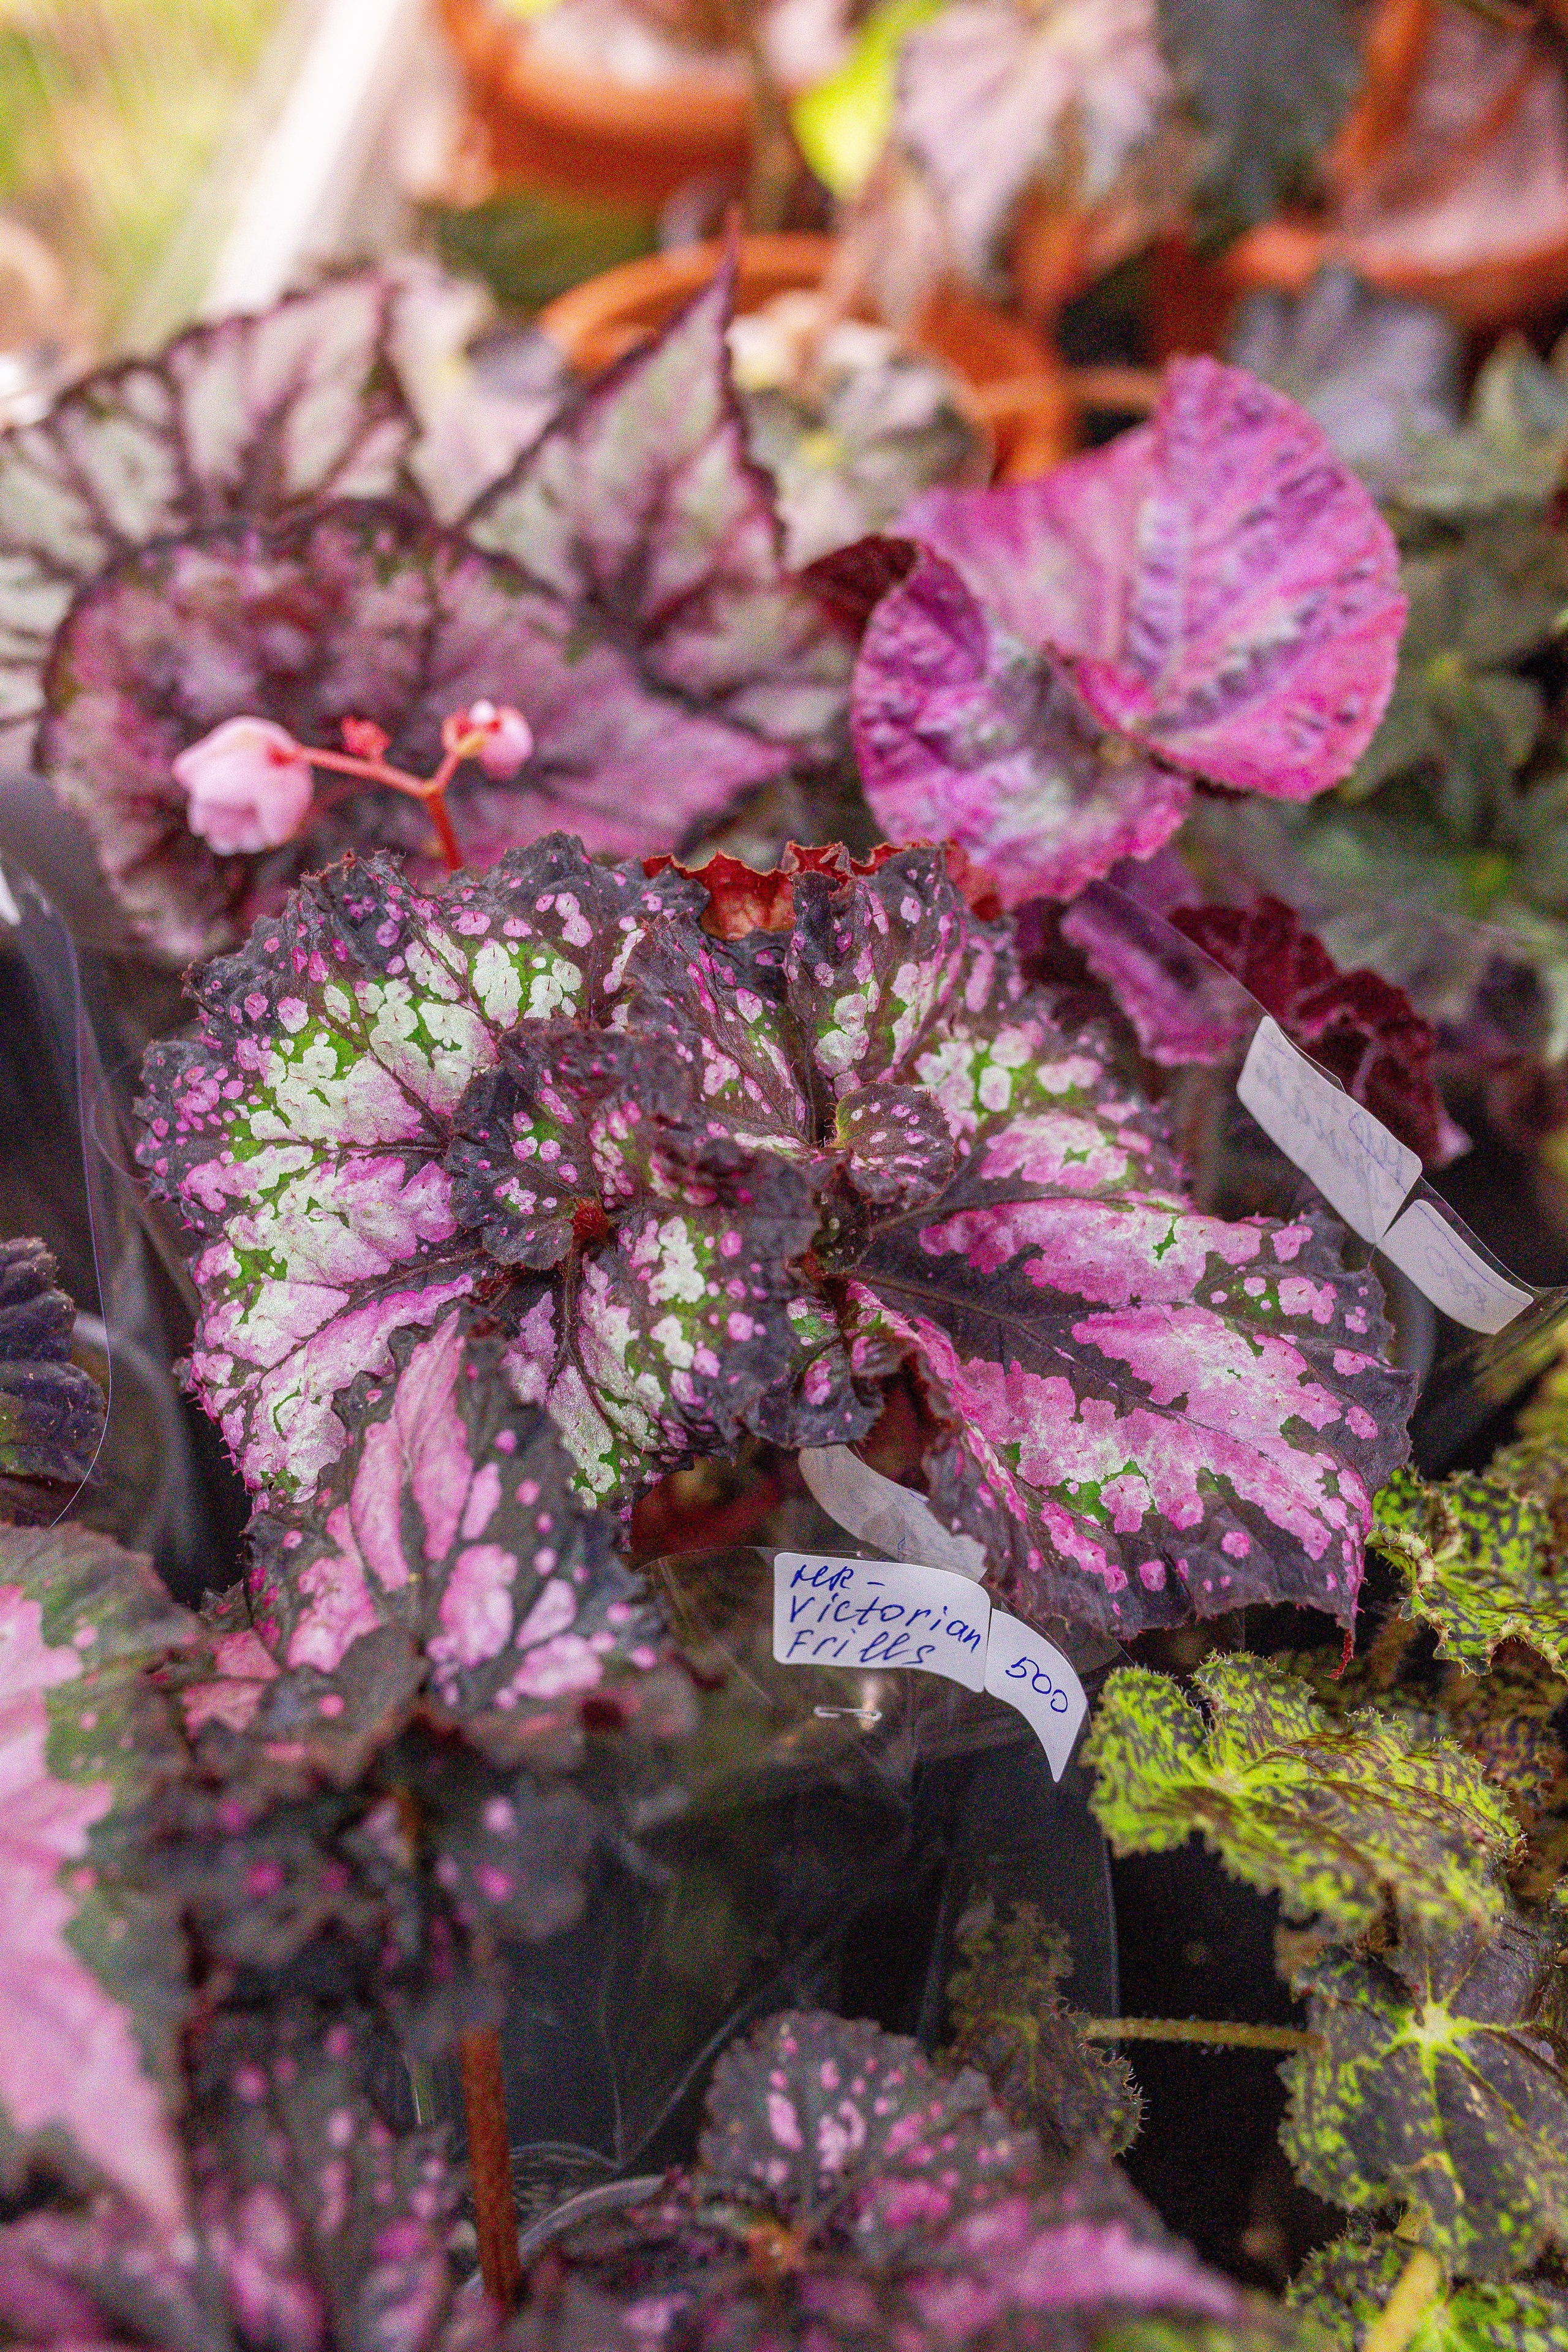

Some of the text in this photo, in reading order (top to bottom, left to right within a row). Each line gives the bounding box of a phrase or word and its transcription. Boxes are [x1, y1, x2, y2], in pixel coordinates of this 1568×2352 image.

[786, 1628, 935, 1665] Frills
[789, 1592, 981, 1653] Victorian
[1006, 1657, 1068, 1713] 500
